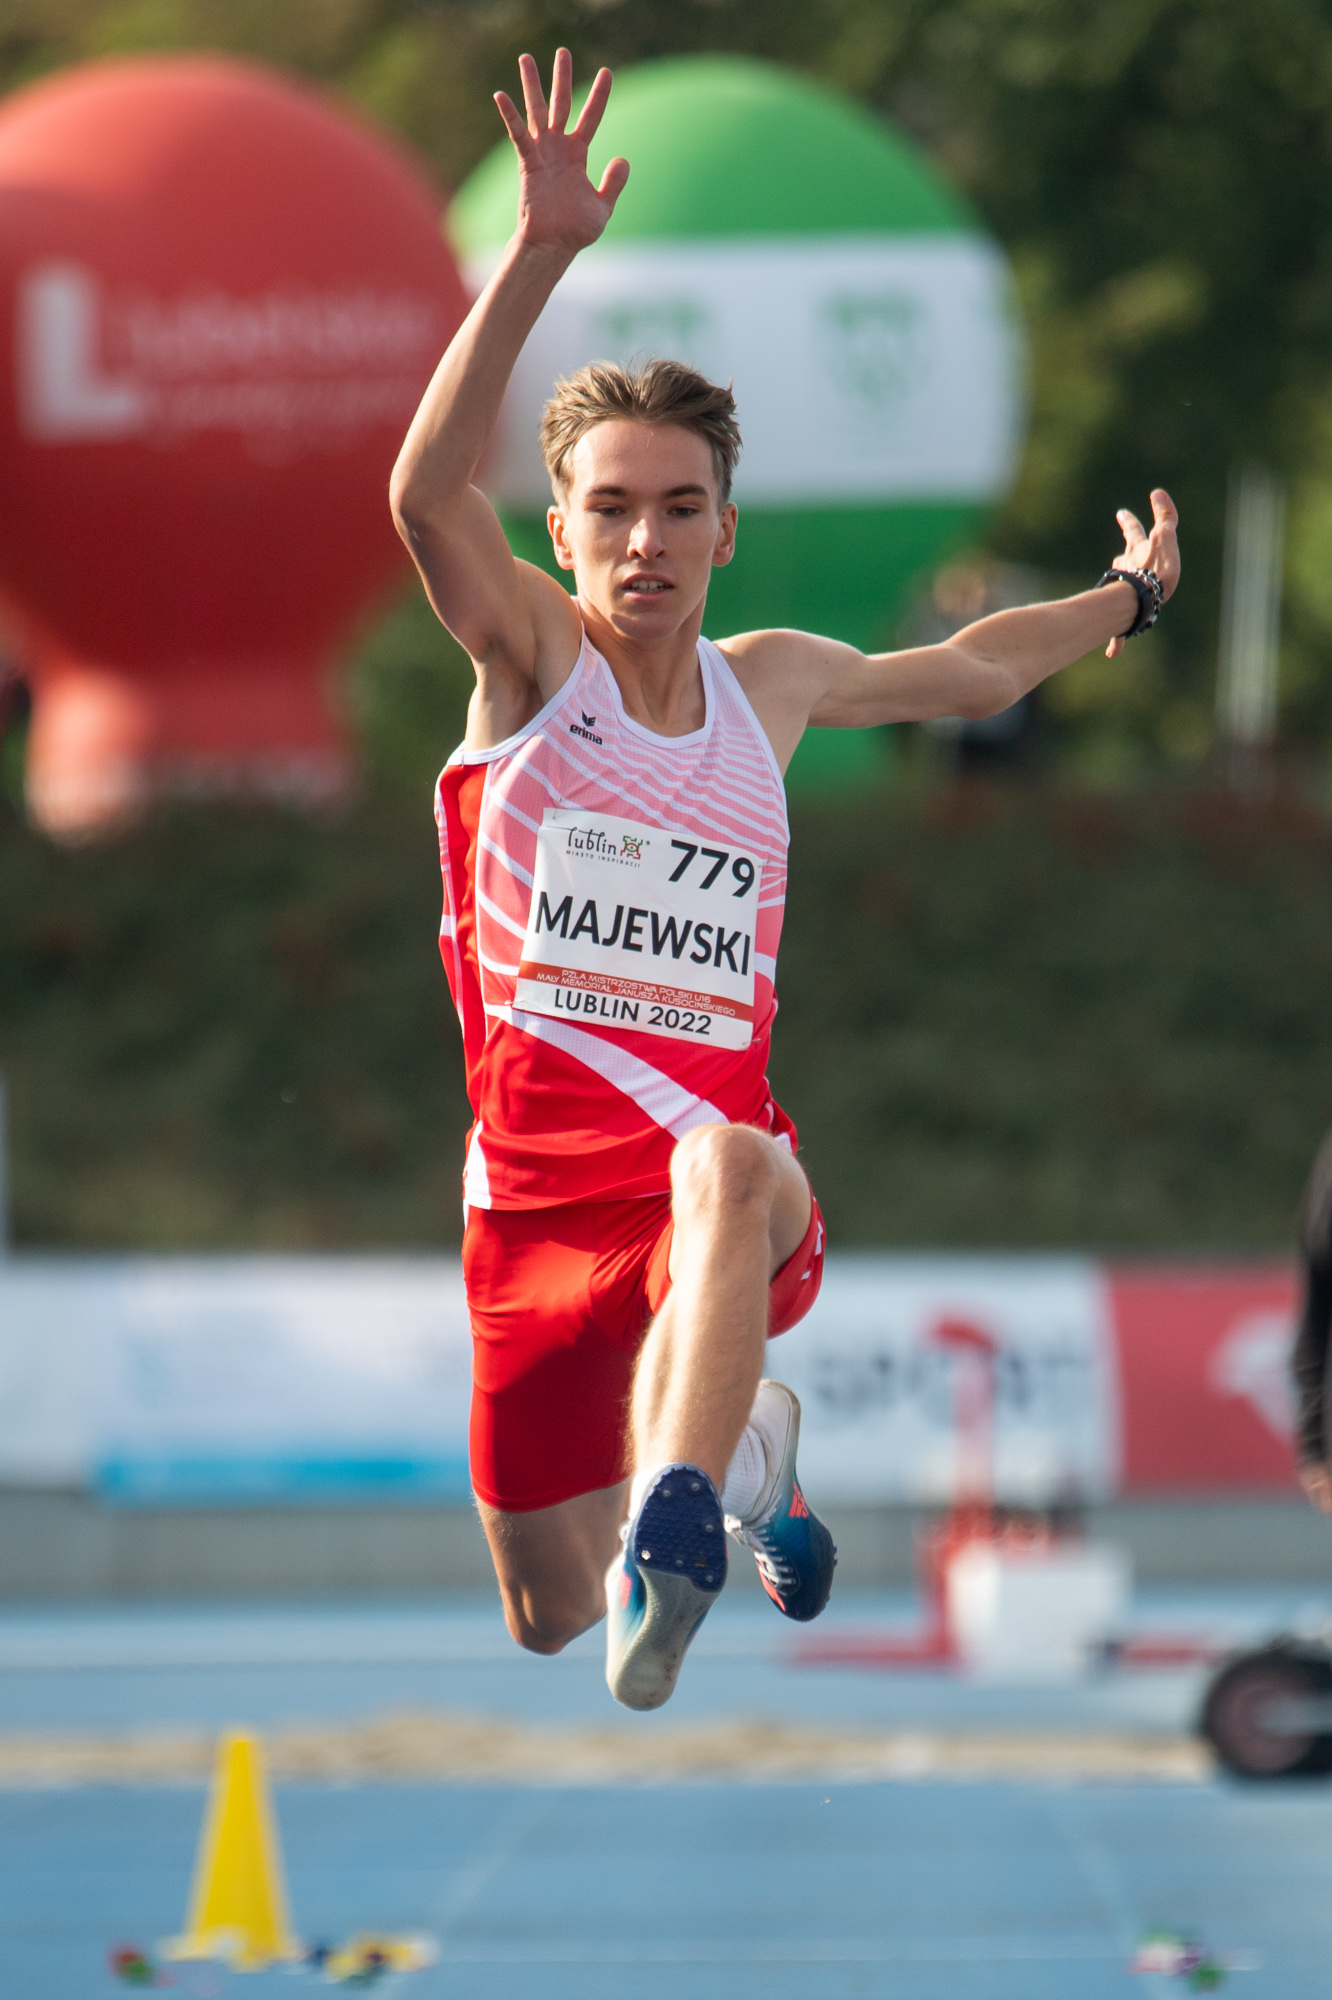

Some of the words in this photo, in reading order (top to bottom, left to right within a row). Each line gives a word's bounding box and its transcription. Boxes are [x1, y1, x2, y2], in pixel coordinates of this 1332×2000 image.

[569, 724, 603, 746] erima
[568, 827, 617, 855] lublin
[566, 850, 594, 859] MIASTO
[598, 855, 641, 868] INSPIRACJI
[668, 839, 755, 898] 779
[534, 891, 751, 976] MAJEWSKI
[560, 978, 612, 993] MEMORIAŁ
[614, 988, 660, 1002] JANUSZA
[561, 969, 586, 980] PZLA
[588, 974, 657, 993] MISTRZOSTWA
[659, 987, 693, 999] POLSKI
[694, 994, 712, 1004] U16
[554, 988, 640, 1022] LUBLIN
[647, 1006, 712, 1036] 2022
